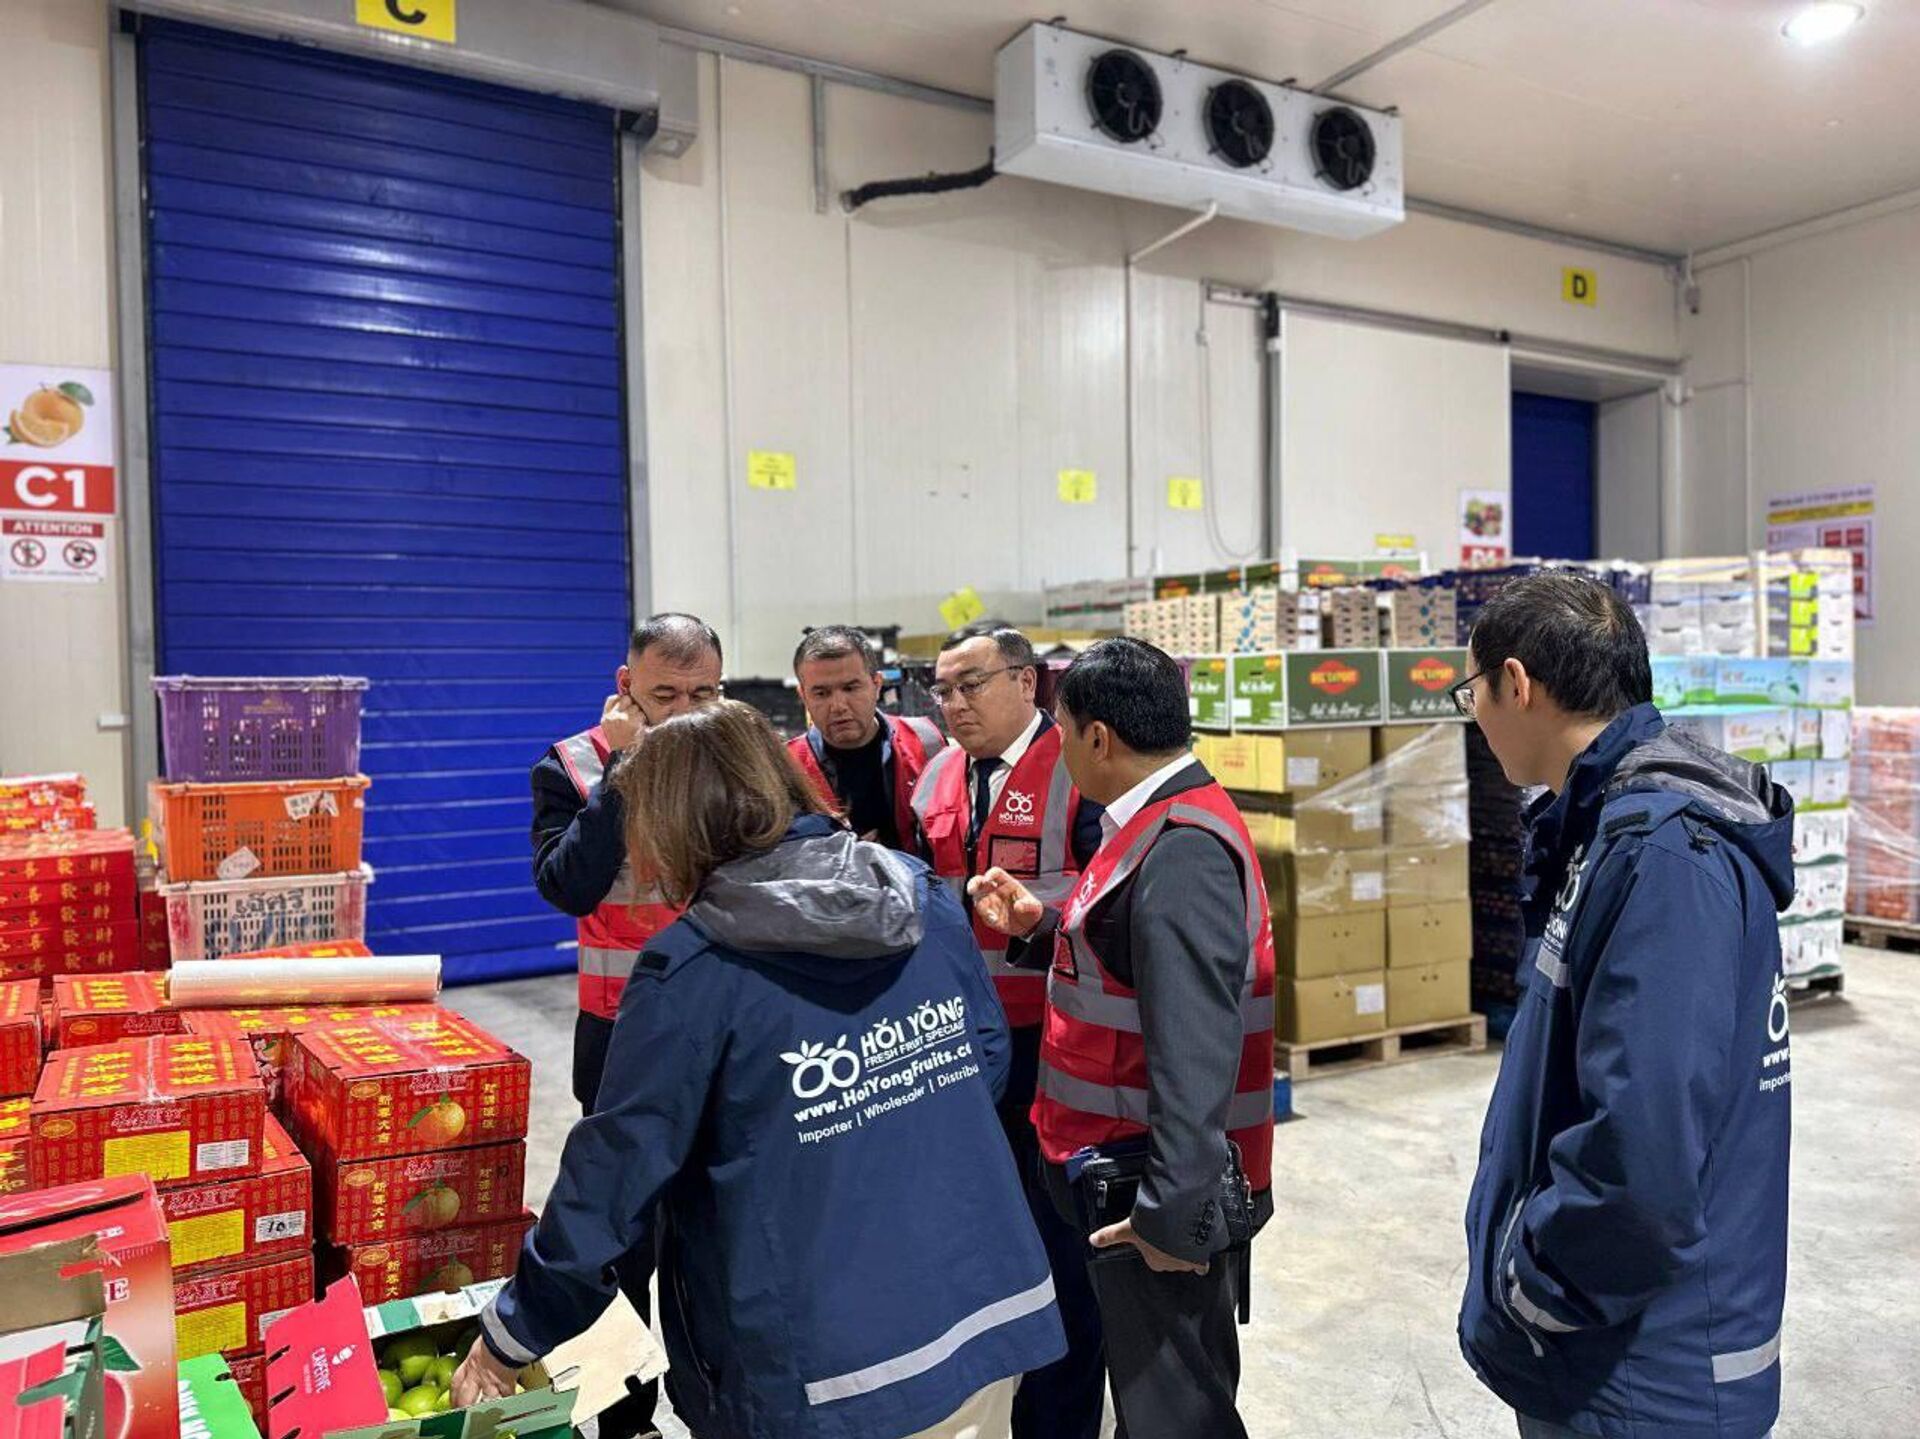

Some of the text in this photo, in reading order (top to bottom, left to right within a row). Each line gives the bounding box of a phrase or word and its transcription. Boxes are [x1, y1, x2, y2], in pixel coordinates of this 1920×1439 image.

[1572, 274, 1588, 299] D
[14, 466, 86, 508] C1
[12, 521, 94, 536] ATTENTION
[865, 1049, 899, 1069] FRESH
[900, 1036, 924, 1054] FRUIT
[799, 1118, 853, 1144] Importer
